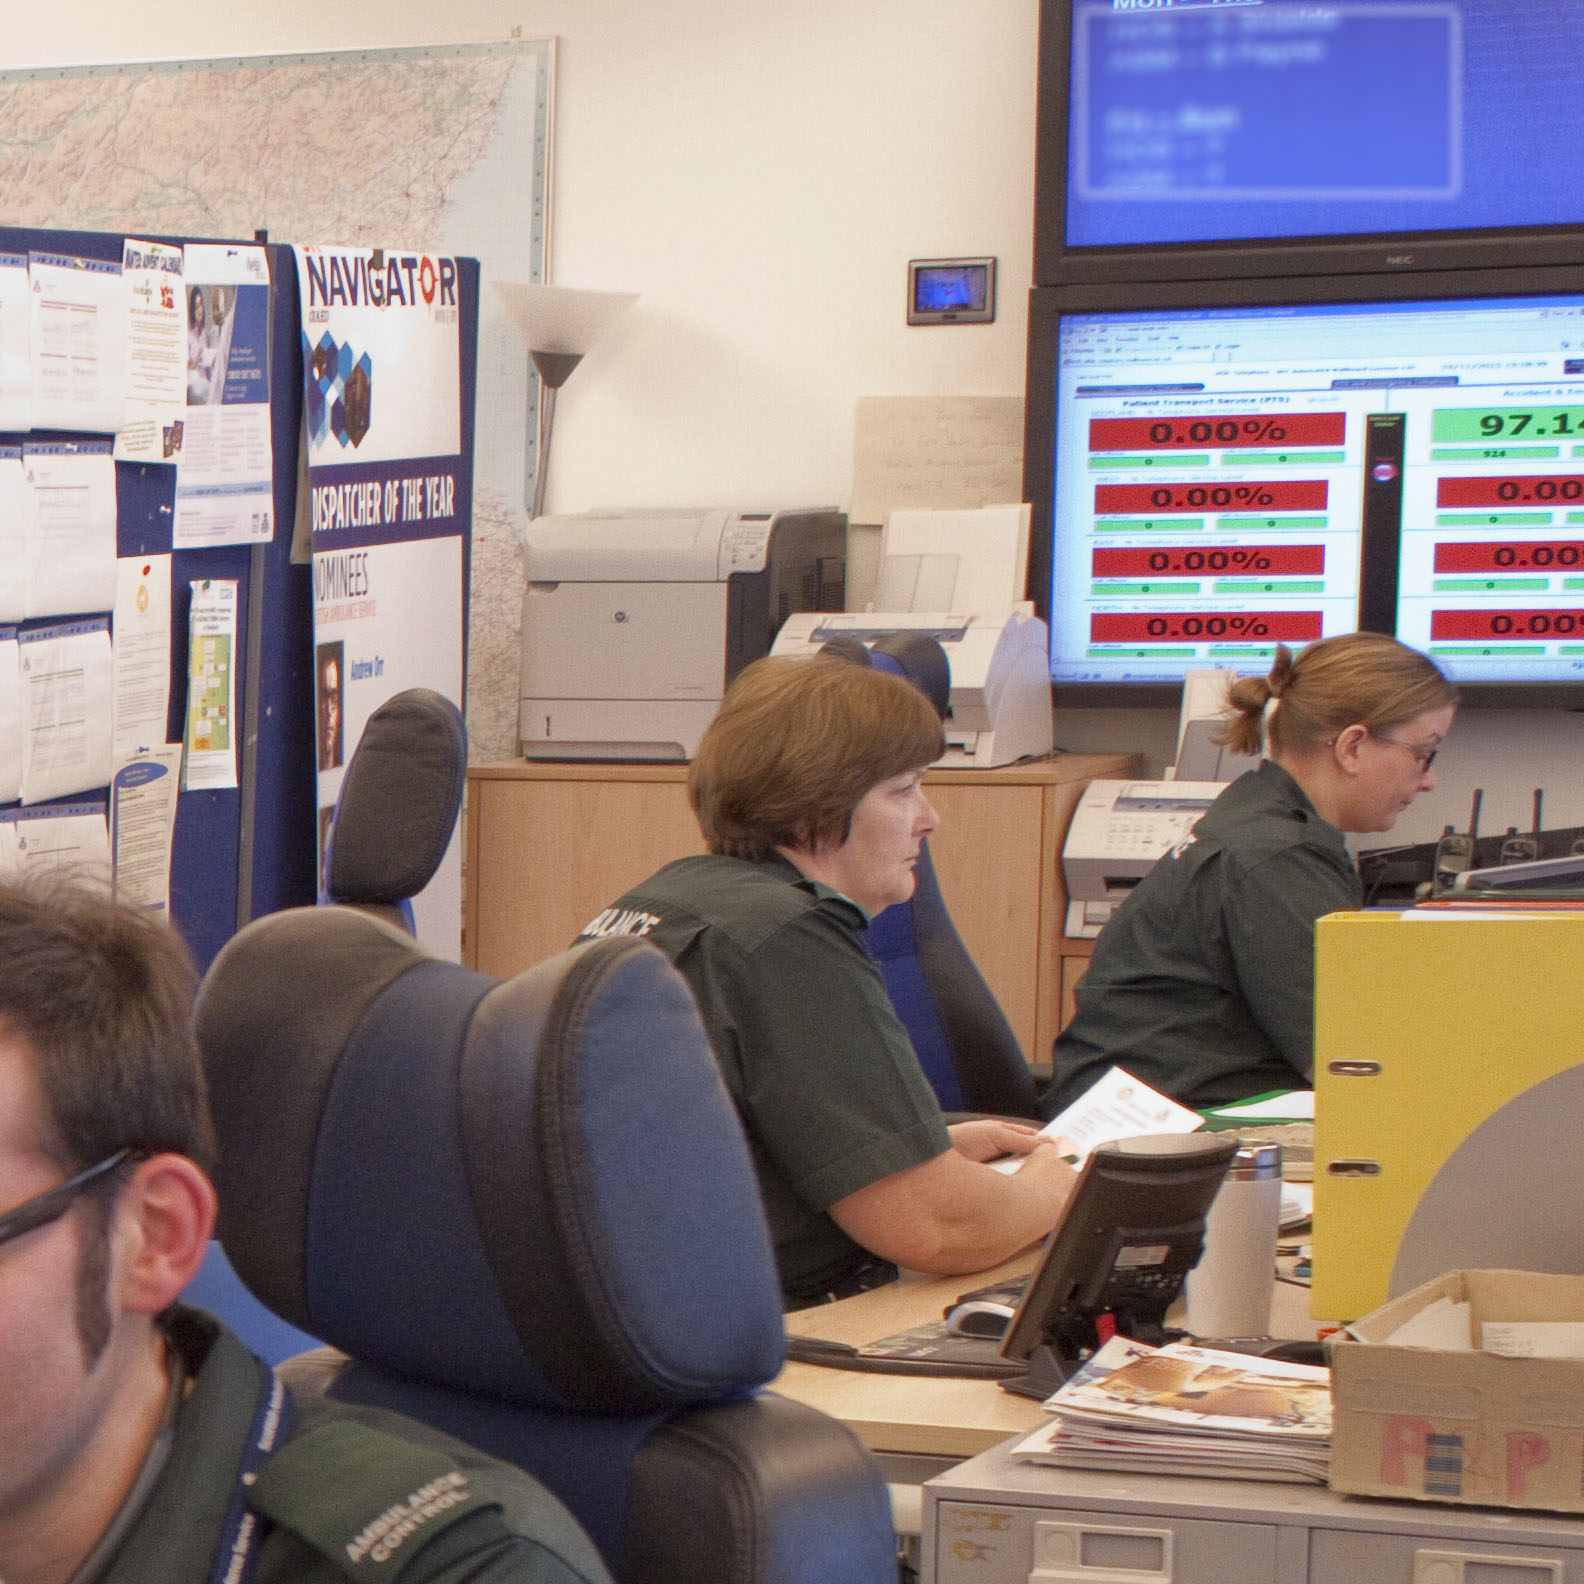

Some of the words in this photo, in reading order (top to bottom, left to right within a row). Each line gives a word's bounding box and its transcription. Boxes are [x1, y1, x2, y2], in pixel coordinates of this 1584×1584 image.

[306, 256, 457, 306] NAVIGATOR
[1123, 399, 1161, 408] Patient
[1163, 397, 1214, 408] Transport
[1218, 397, 1255, 405] Service
[1150, 420, 1286, 443] 0.00%
[312, 481, 381, 532] DISPATCHER
[385, 479, 399, 523] OF
[402, 476, 423, 520] THE
[425, 475, 454, 518] YEAR
[1151, 486, 1273, 507] 0.00%
[1149, 551, 1270, 571] 0.00%
[1494, 547, 1584, 567] 0.00
[1147, 617, 1268, 636] 0.00%
[1491, 615, 1584, 634] 0.00
[351, 658, 373, 680] Andrew
[346, 1472, 469, 1562] AMBULANCE
[371, 1490, 473, 1562] CONTROL
